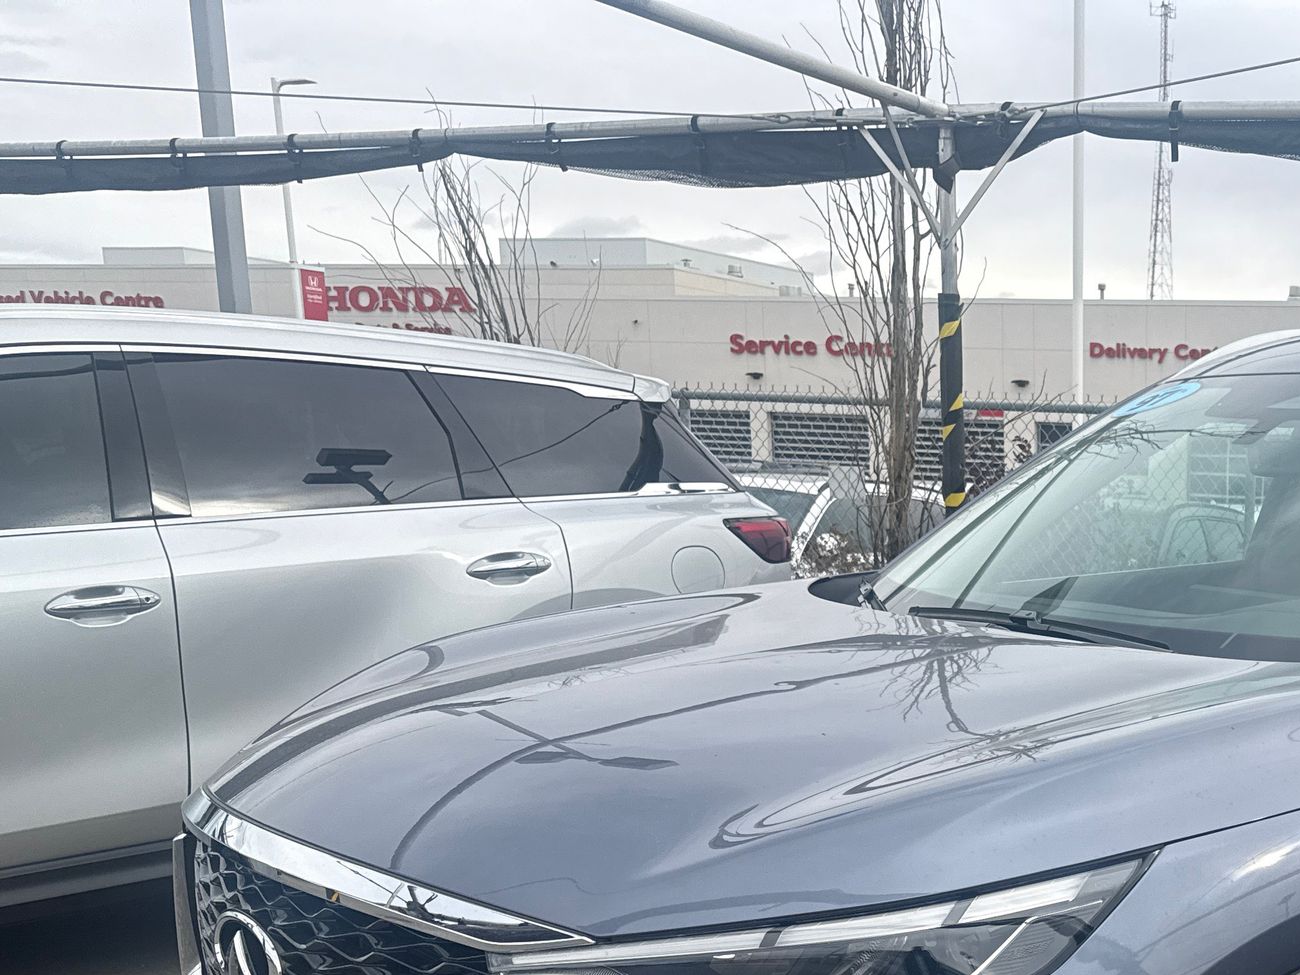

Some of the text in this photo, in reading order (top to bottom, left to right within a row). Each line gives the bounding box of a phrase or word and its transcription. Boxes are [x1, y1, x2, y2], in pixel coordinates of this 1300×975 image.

[28, 290, 96, 305] Vehicle
[100, 290, 165, 308] Centre
[326, 285, 477, 313] HONDA
[729, 333, 818, 356] Service
[1089, 342, 1219, 364] Delivery Cen
